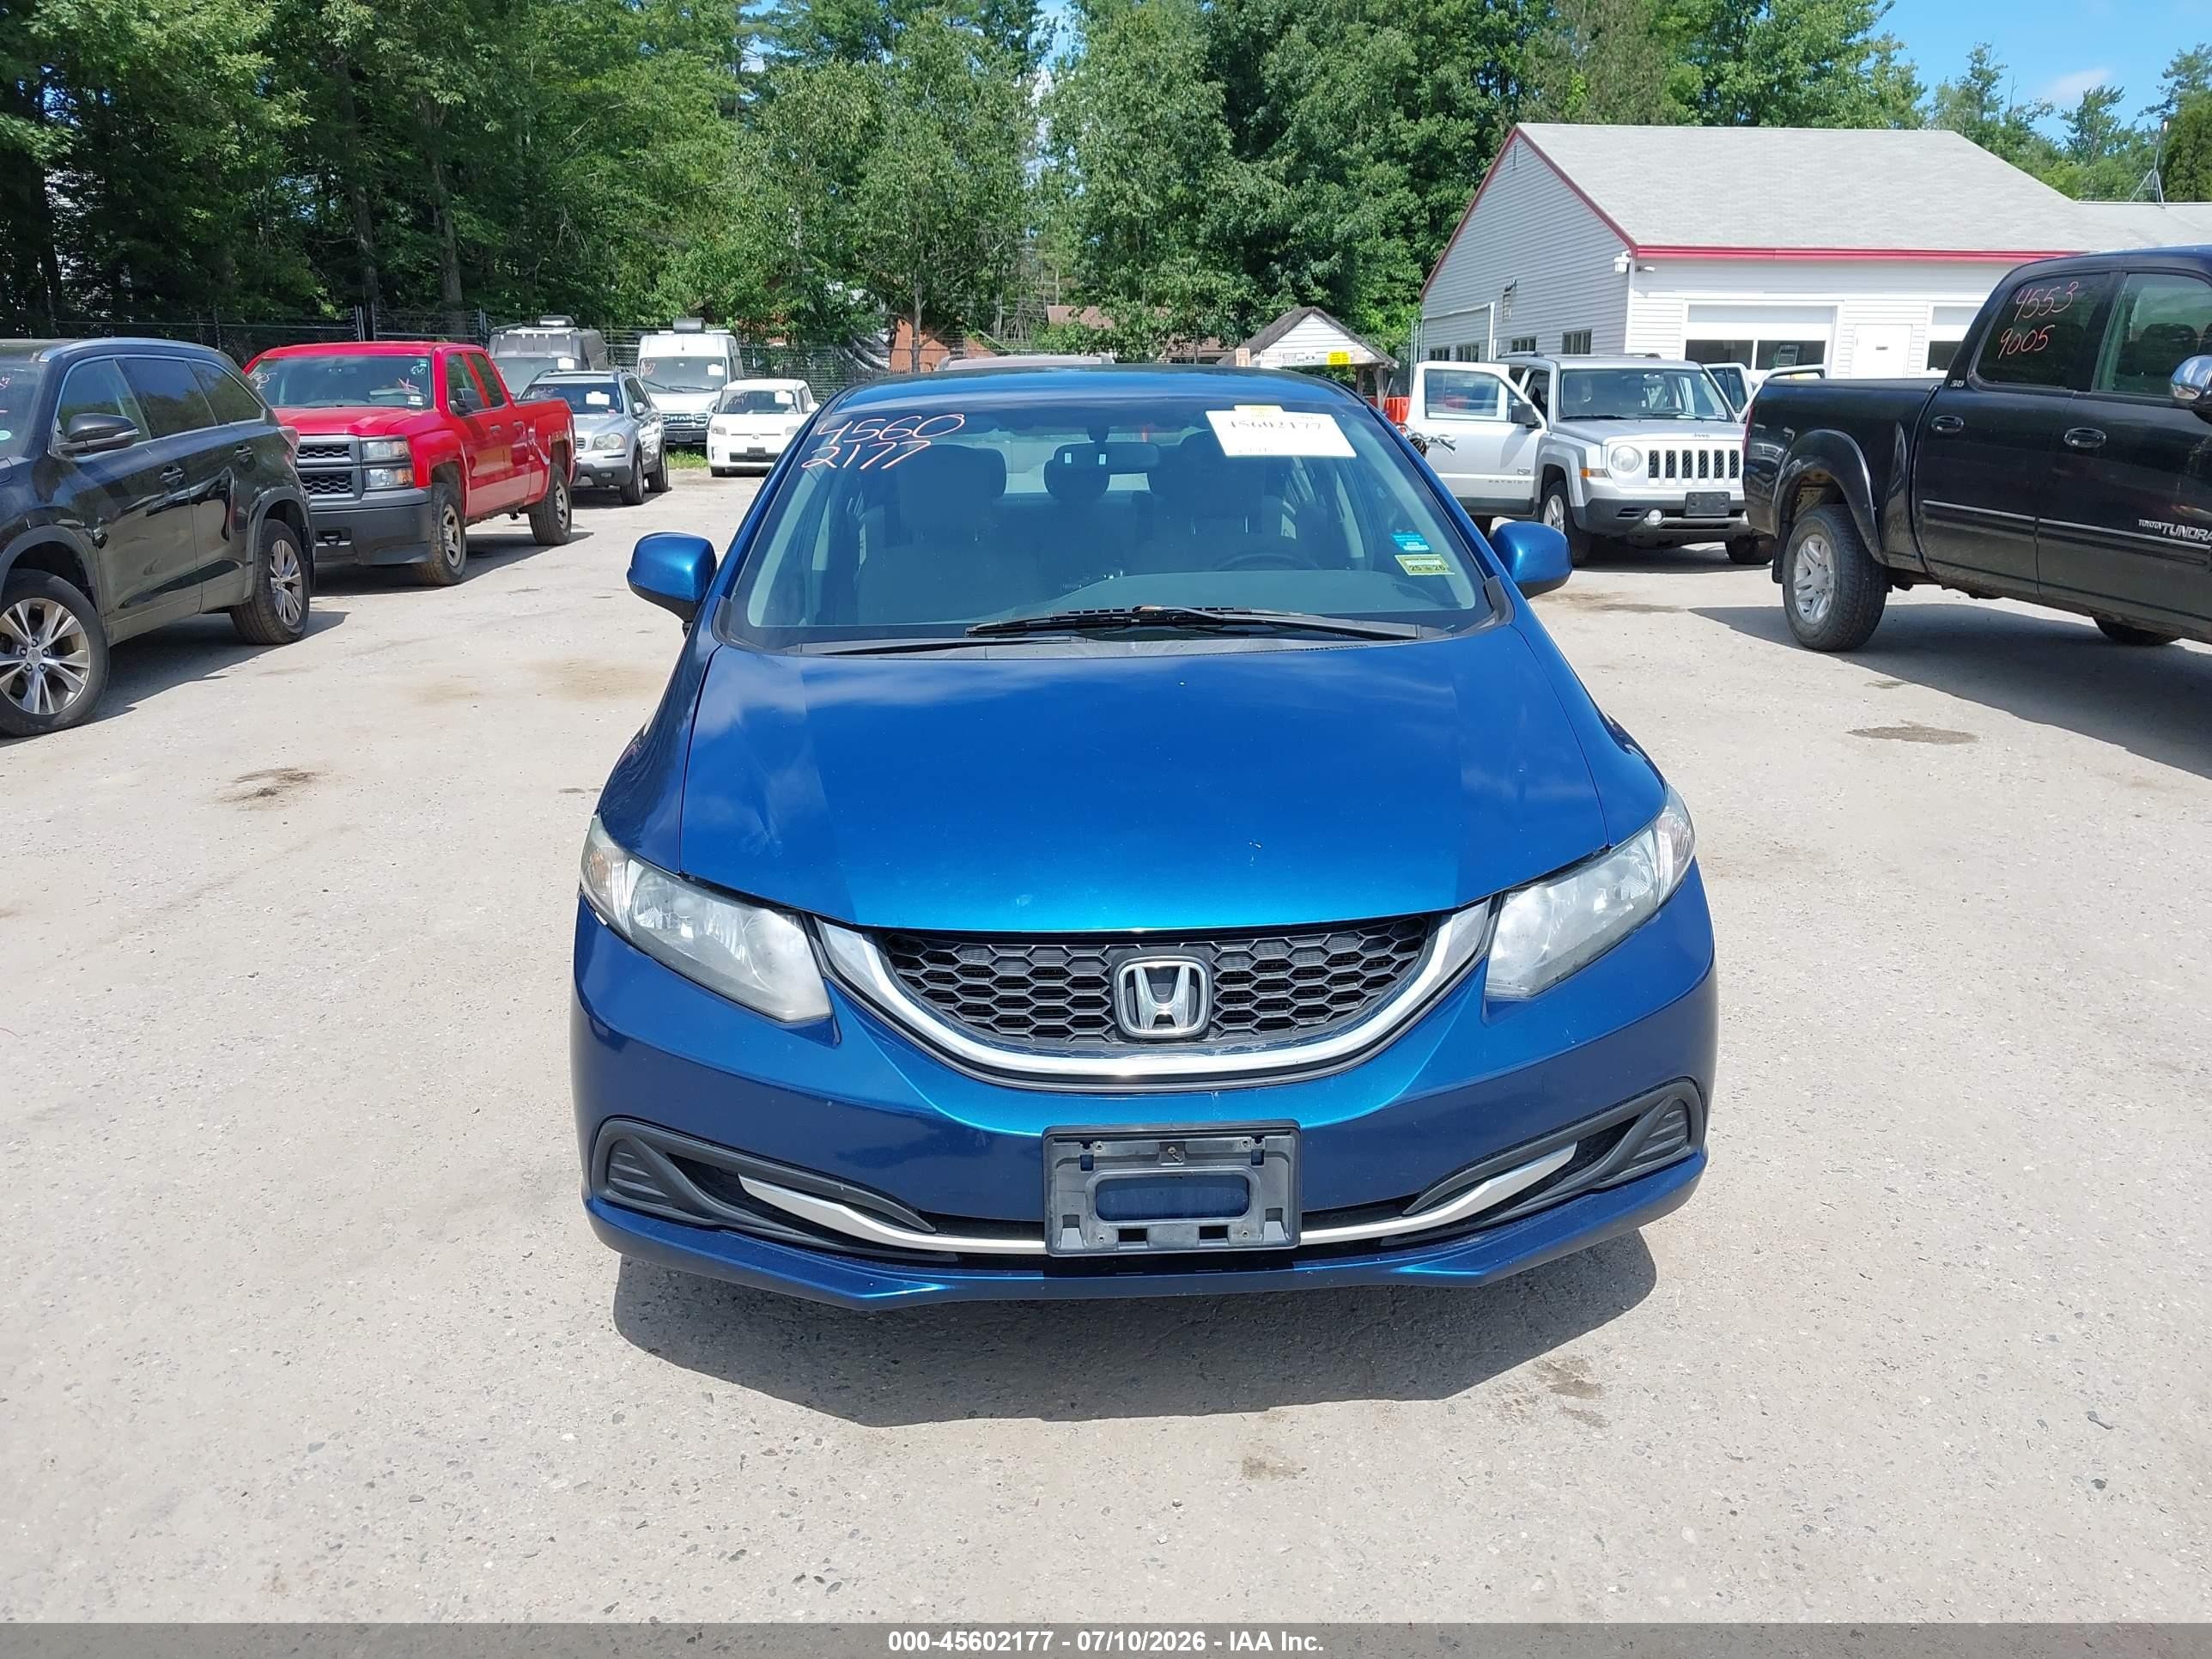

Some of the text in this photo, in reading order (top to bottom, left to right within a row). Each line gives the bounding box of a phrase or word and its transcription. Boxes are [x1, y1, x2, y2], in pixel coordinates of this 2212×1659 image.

[2014, 281, 2079, 322] 4553
[1998, 324, 2056, 359] 9005
[817, 414, 965, 445] 4560
[801, 441, 932, 470] 2177
